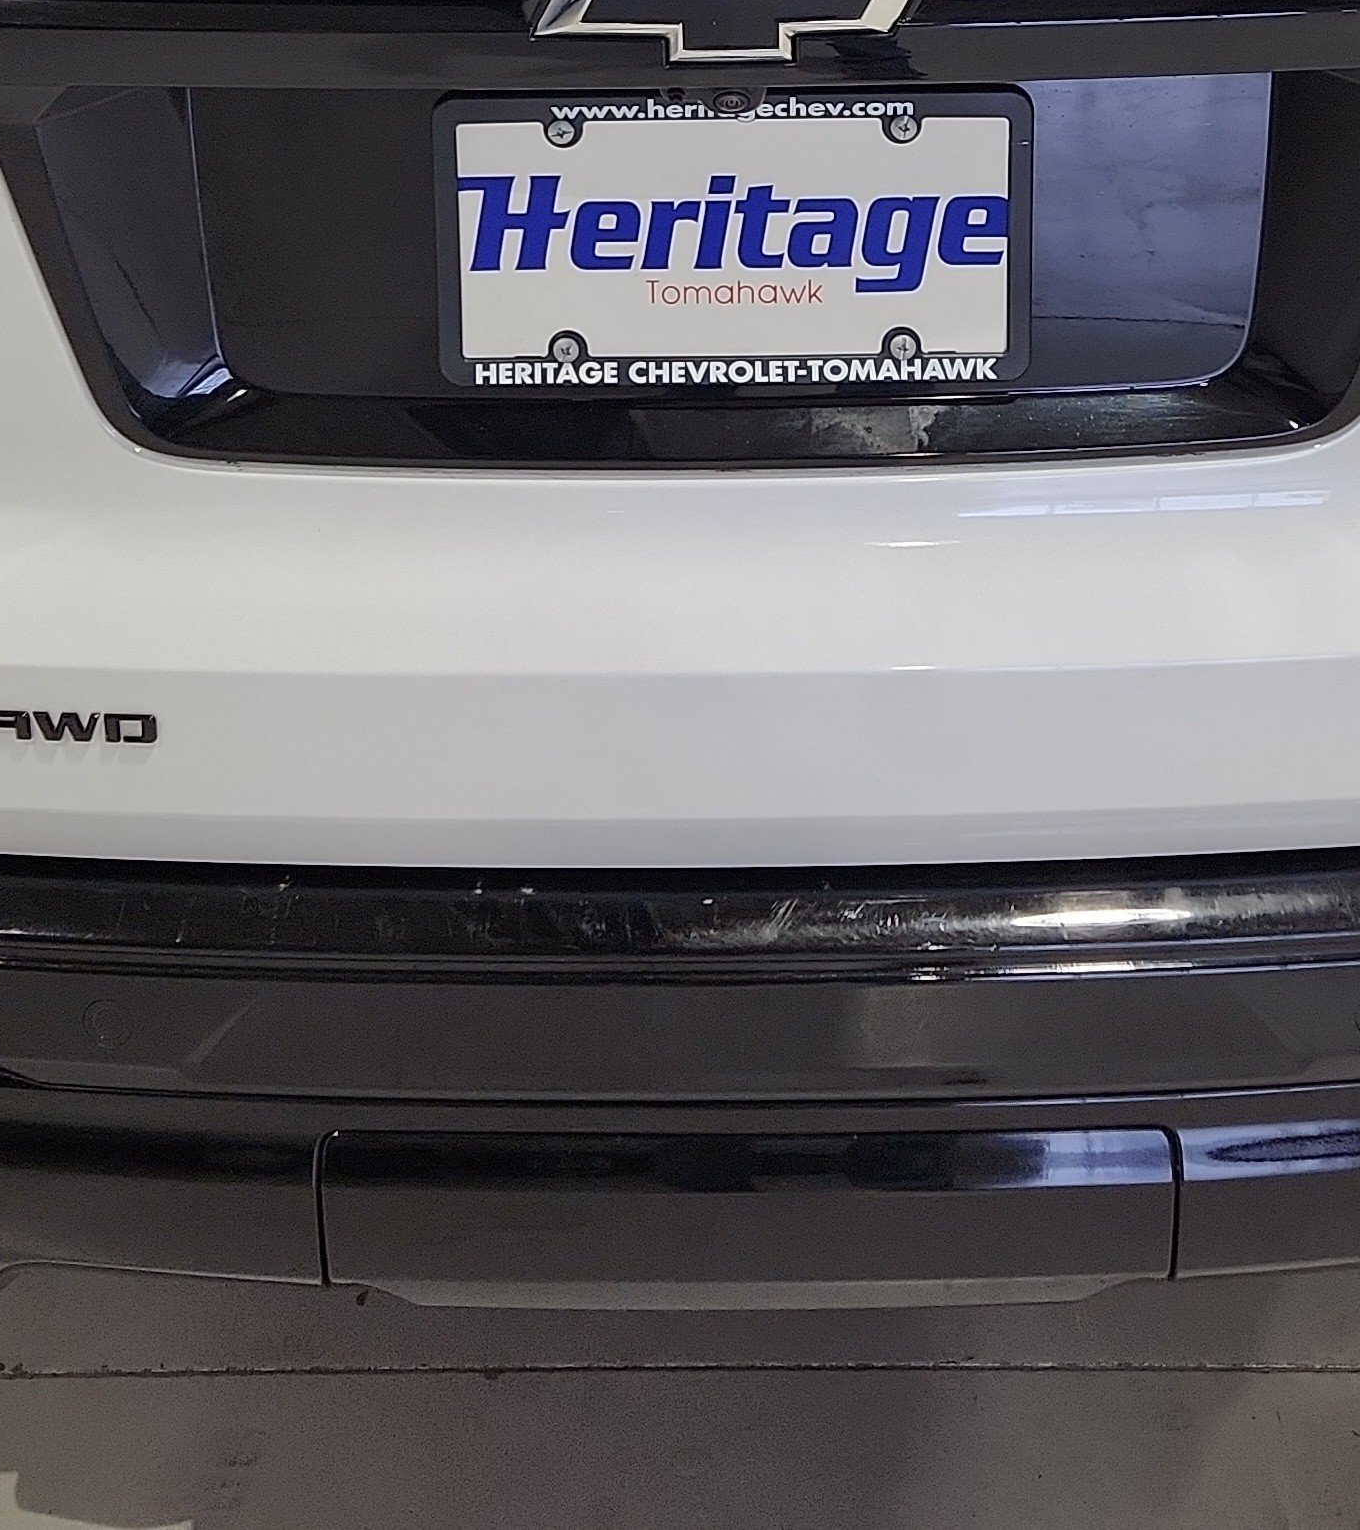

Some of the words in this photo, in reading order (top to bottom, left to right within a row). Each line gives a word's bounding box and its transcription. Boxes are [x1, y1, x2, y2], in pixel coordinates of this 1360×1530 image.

[550, 96, 914, 123] www.herigechev.com
[456, 174, 1010, 293] Heritage
[646, 279, 824, 305] Tomahawk
[475, 362, 619, 386] HERITAGE
[628, 357, 999, 384] CHEVROLET-TOMAHAWK
